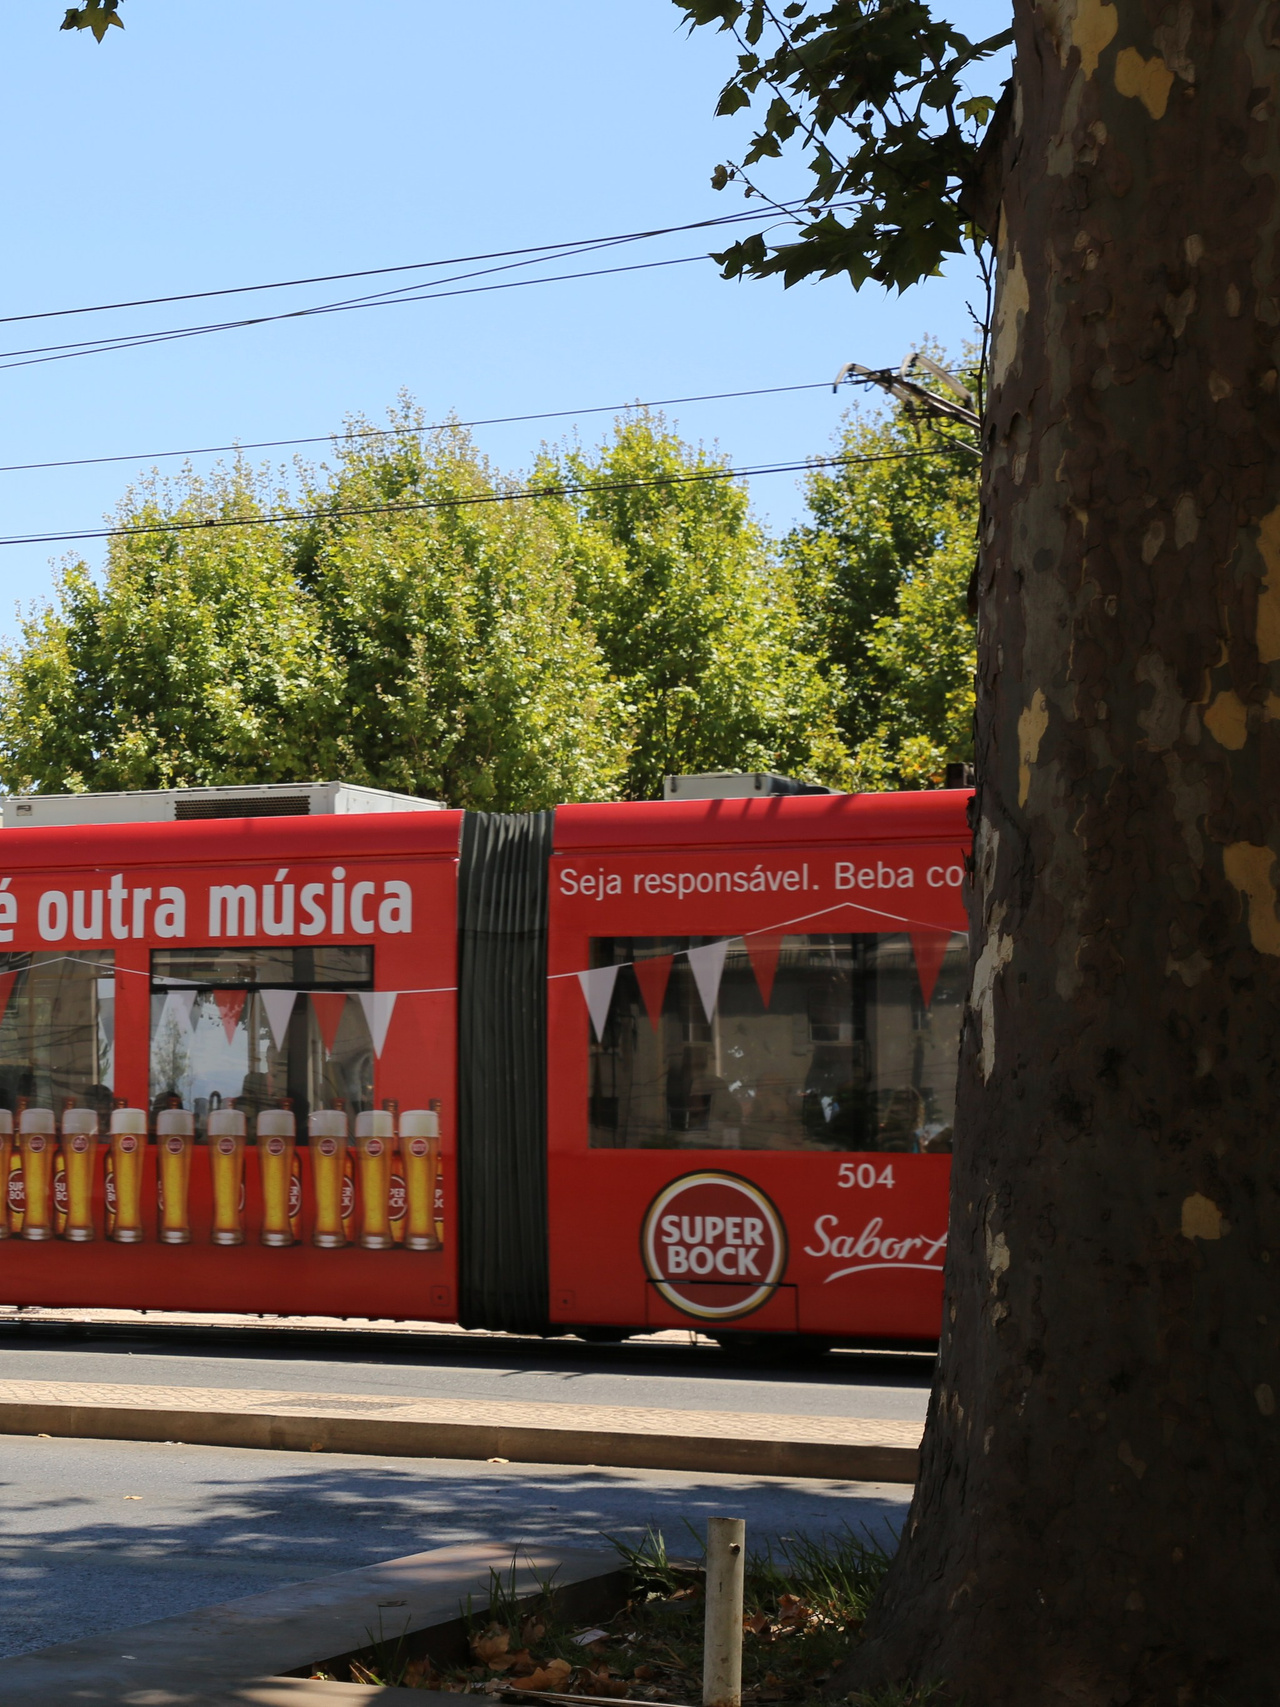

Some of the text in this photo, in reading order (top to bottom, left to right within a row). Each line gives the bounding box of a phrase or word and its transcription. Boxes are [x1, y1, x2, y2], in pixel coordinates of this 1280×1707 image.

[559, 861, 964, 901] Seja responsável. Beba co
[37, 873, 187, 942] outra
[208, 866, 413, 937] música
[837, 1163, 896, 1189] 504
[660, 1215, 765, 1246] SUPER
[804, 1214, 923, 1260] Sabor
[667, 1245, 761, 1276] BOCK
